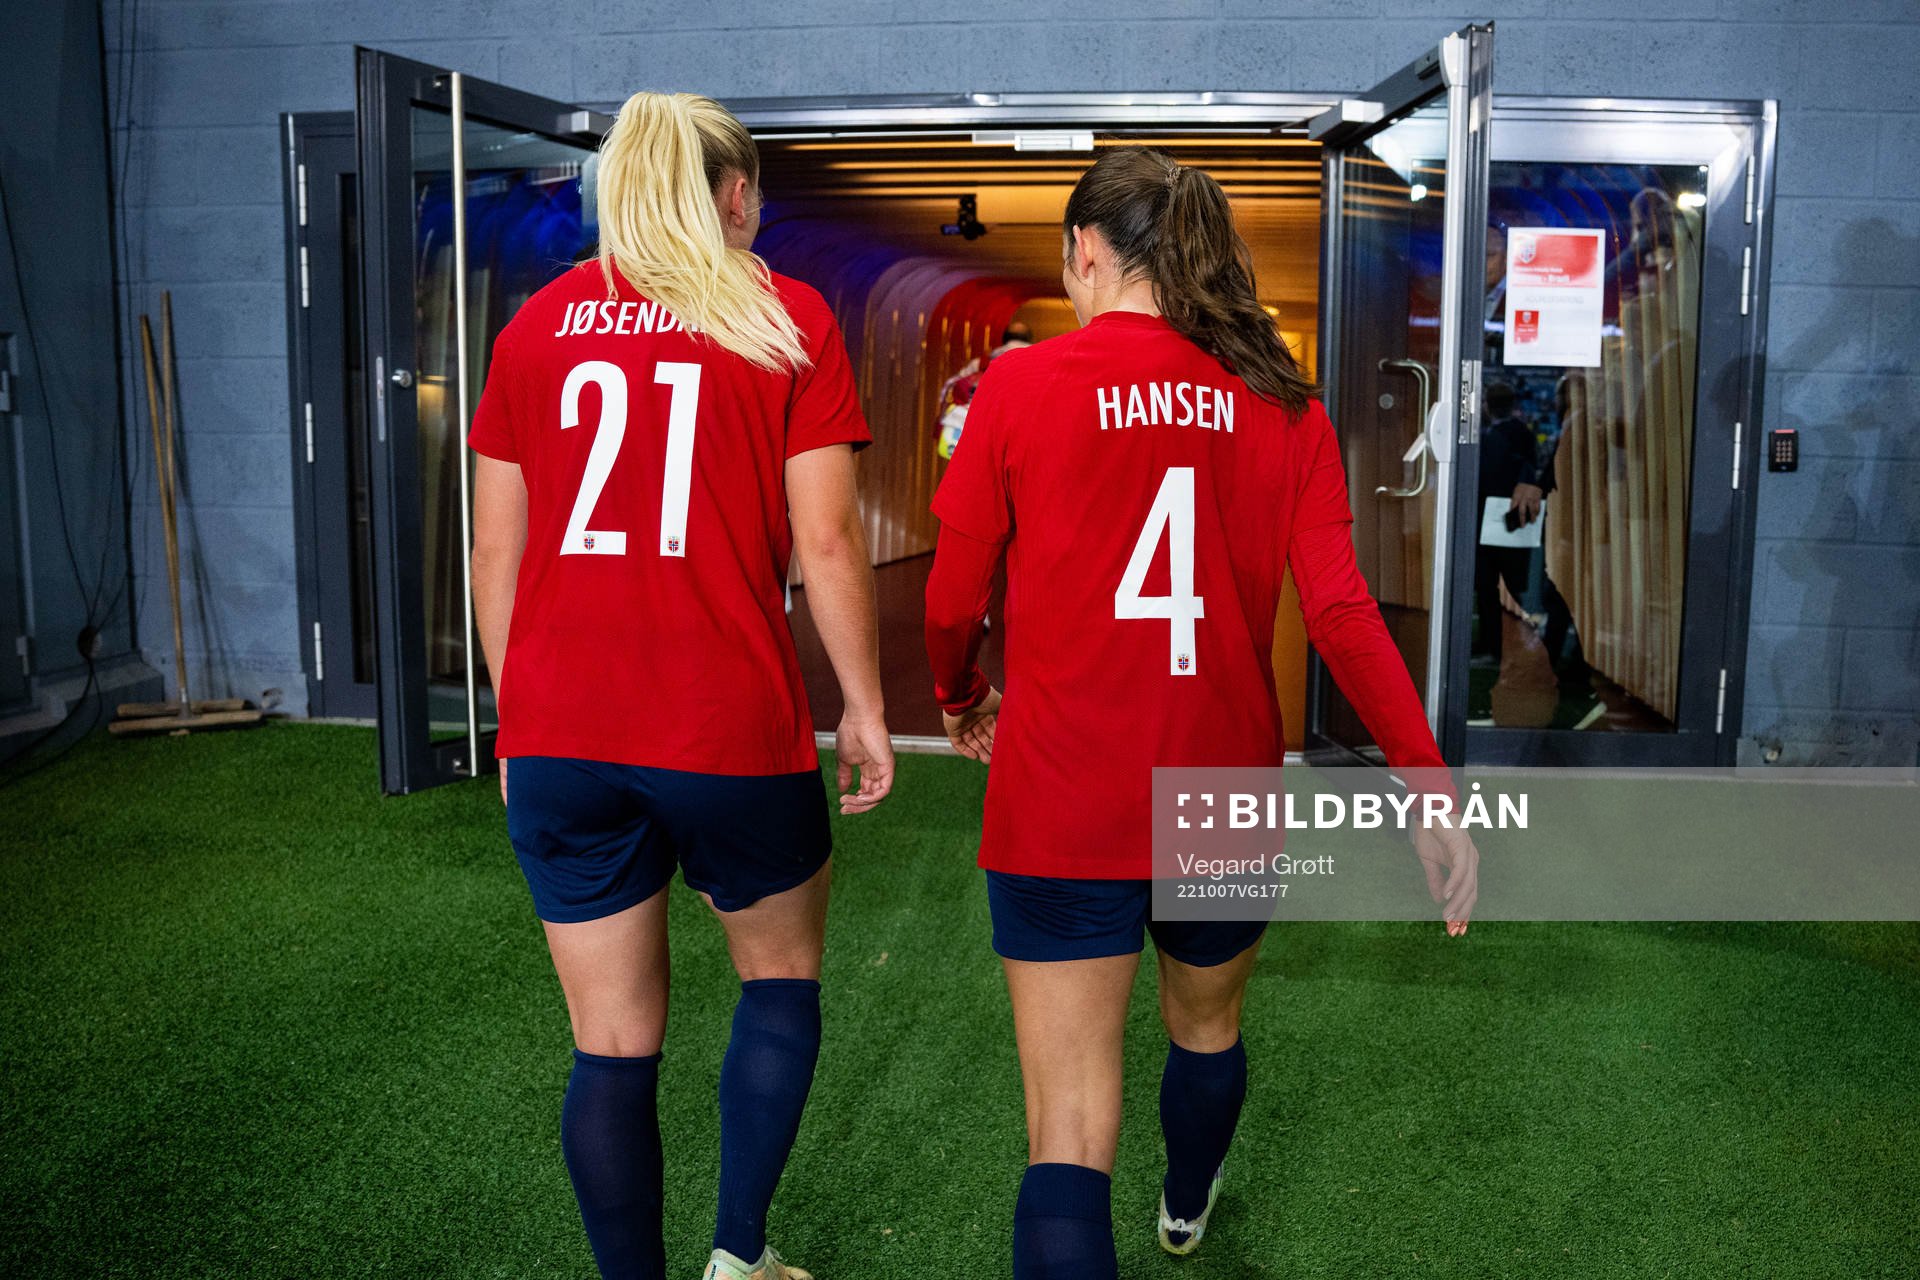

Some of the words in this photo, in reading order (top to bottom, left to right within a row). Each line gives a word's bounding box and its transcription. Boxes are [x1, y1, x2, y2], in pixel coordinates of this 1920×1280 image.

[555, 299, 707, 338] JØSEND
[559, 360, 702, 557] 21
[1096, 381, 1234, 433] HANSEN
[1114, 466, 1205, 675] 4
